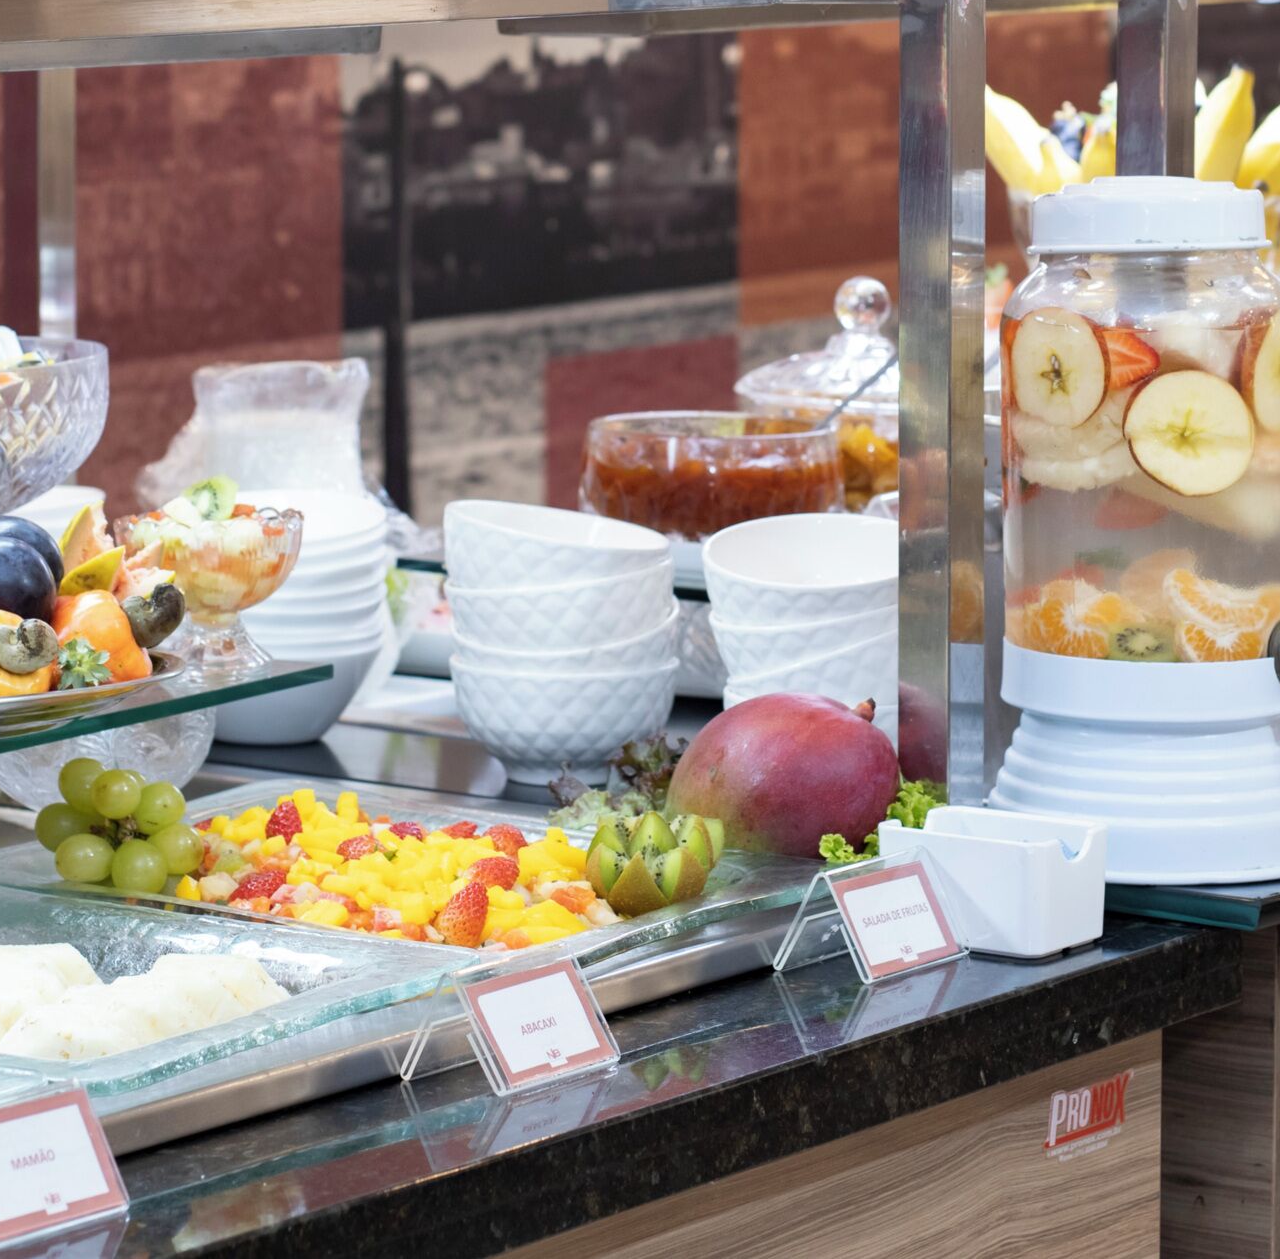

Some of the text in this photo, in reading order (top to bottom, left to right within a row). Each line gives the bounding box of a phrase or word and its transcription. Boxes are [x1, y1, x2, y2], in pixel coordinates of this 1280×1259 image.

[862, 903, 929, 928] SALADA DE FRUTAS
[520, 1016, 557, 1036] ABACAXI
[1049, 1073, 1130, 1147] PRONOX
[10, 1148, 56, 1171] MAMÃO
